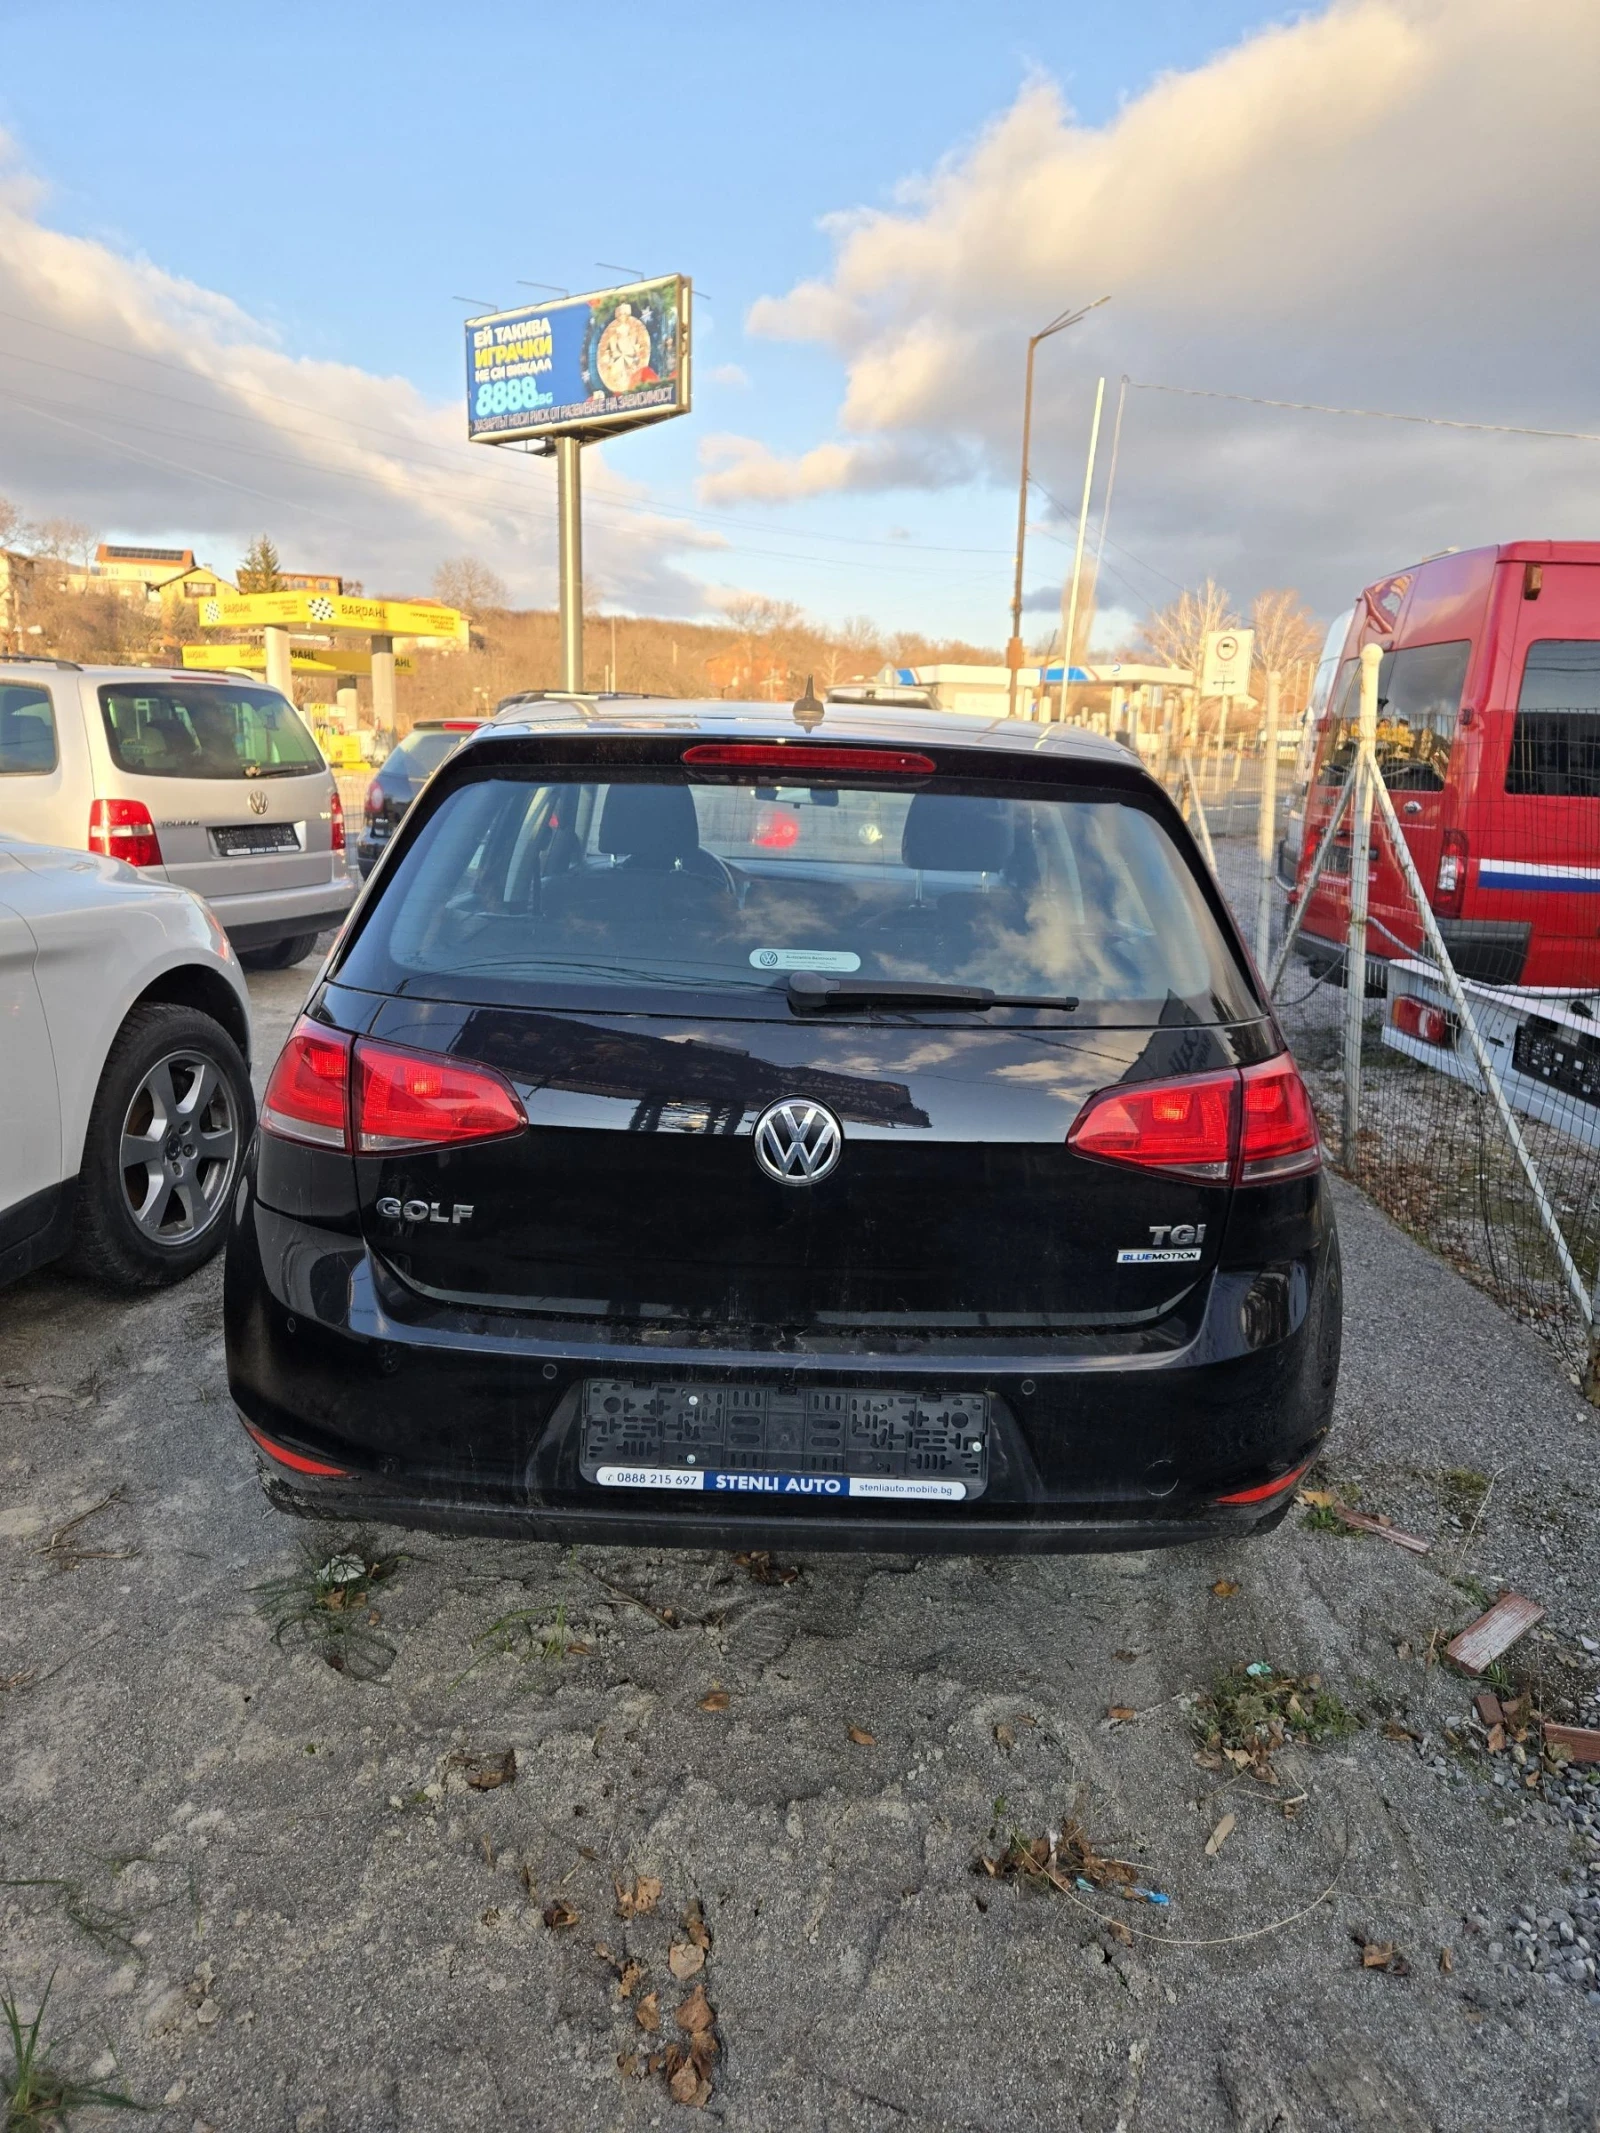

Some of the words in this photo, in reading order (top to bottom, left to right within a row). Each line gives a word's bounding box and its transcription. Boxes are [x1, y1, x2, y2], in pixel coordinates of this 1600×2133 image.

[474, 325, 494, 349] ЕЙ
[494, 317, 552, 345] ТАКИВА
[475, 335, 553, 369] ИГРАЧКИ
[475, 368, 490, 384] НЕ
[490, 365, 506, 381] СИ
[341, 604, 388, 620] BARDAHL
[290, 650, 317, 661] DAHL
[394, 658, 412, 668] AHL
[376, 1197, 475, 1224] GOLF
[1149, 1223, 1207, 1246] TGI
[1122, 1251, 1197, 1261] BLUEMOTION
[616, 1472, 646, 1484] 0888
[650, 1474, 672, 1485] 215
[675, 1475, 697, 1486] 697
[715, 1474, 779, 1491] STENLI
[785, 1477, 841, 1494] AUTO
[859, 1483, 953, 1496] stenliauto.mobile.bg
